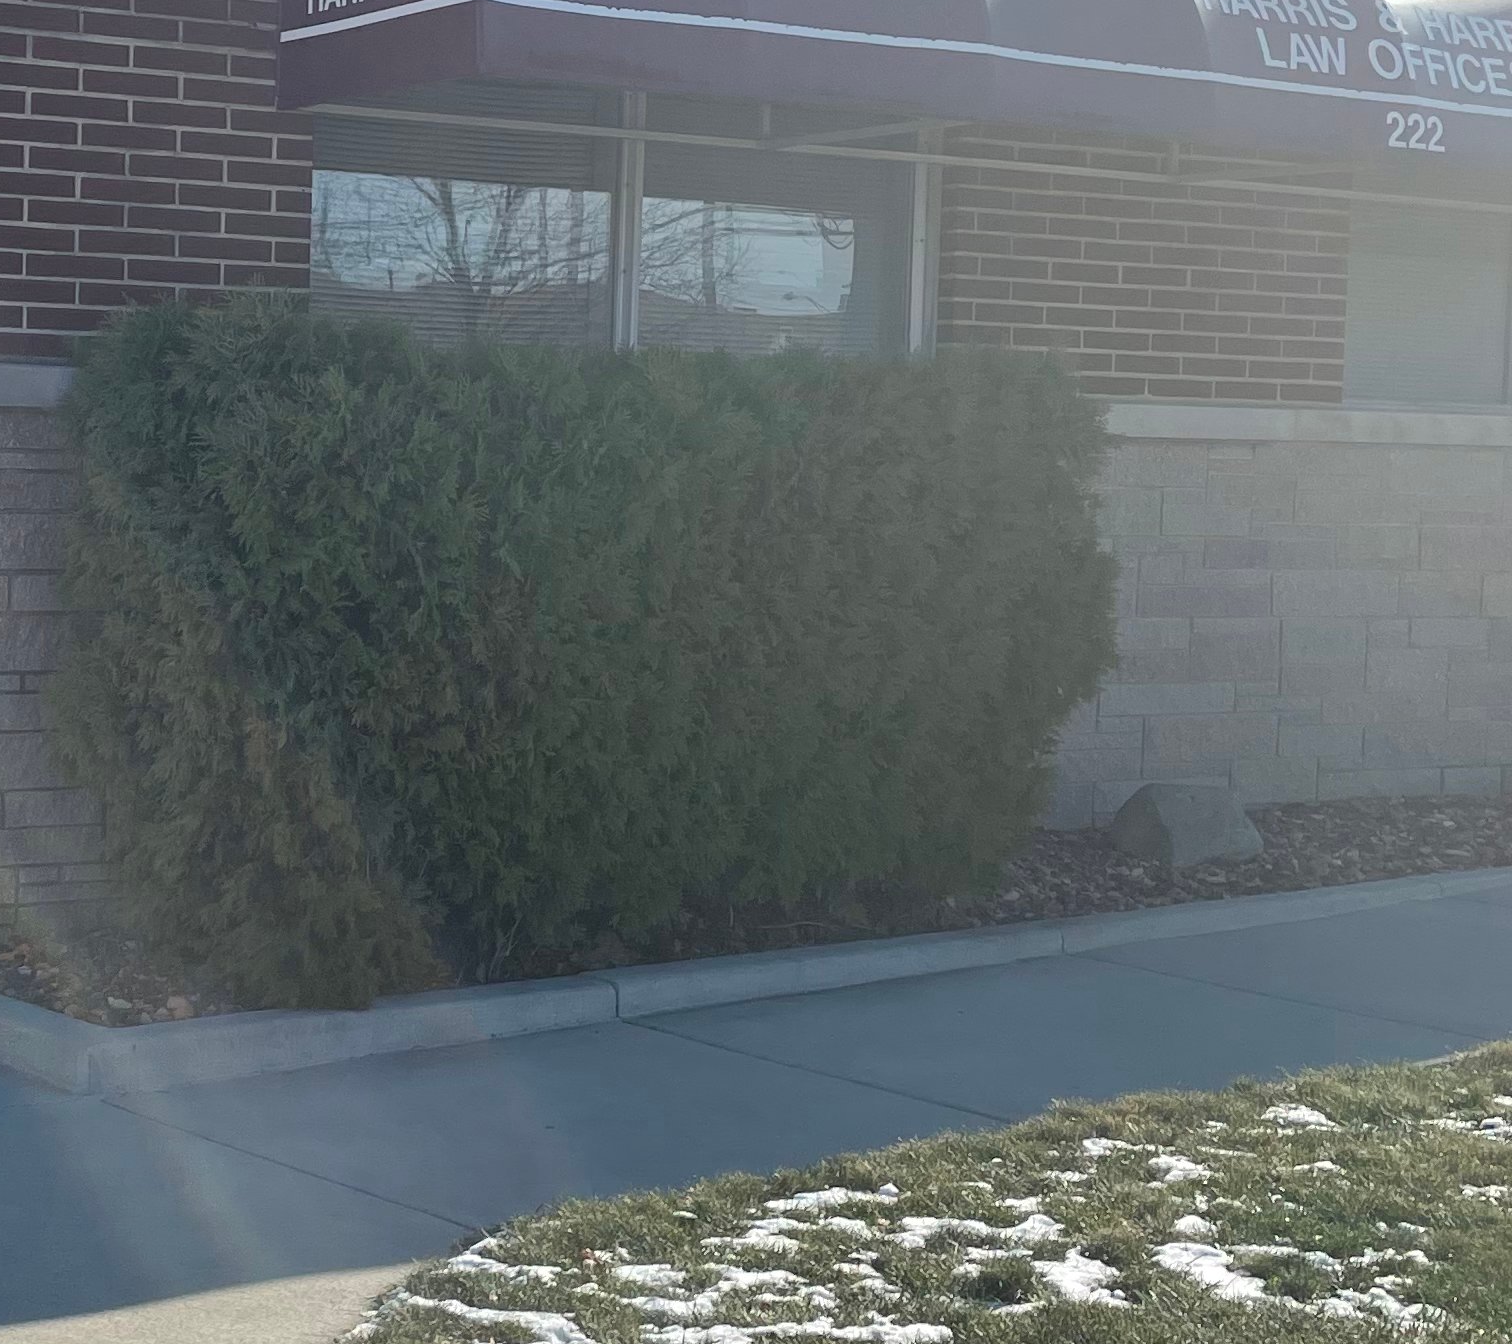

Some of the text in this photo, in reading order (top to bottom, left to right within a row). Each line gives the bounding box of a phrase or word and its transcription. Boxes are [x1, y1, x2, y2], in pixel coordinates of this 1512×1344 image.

[1255, 26, 1512, 97] LAW OFFICE
[1386, 111, 1446, 153] 222
